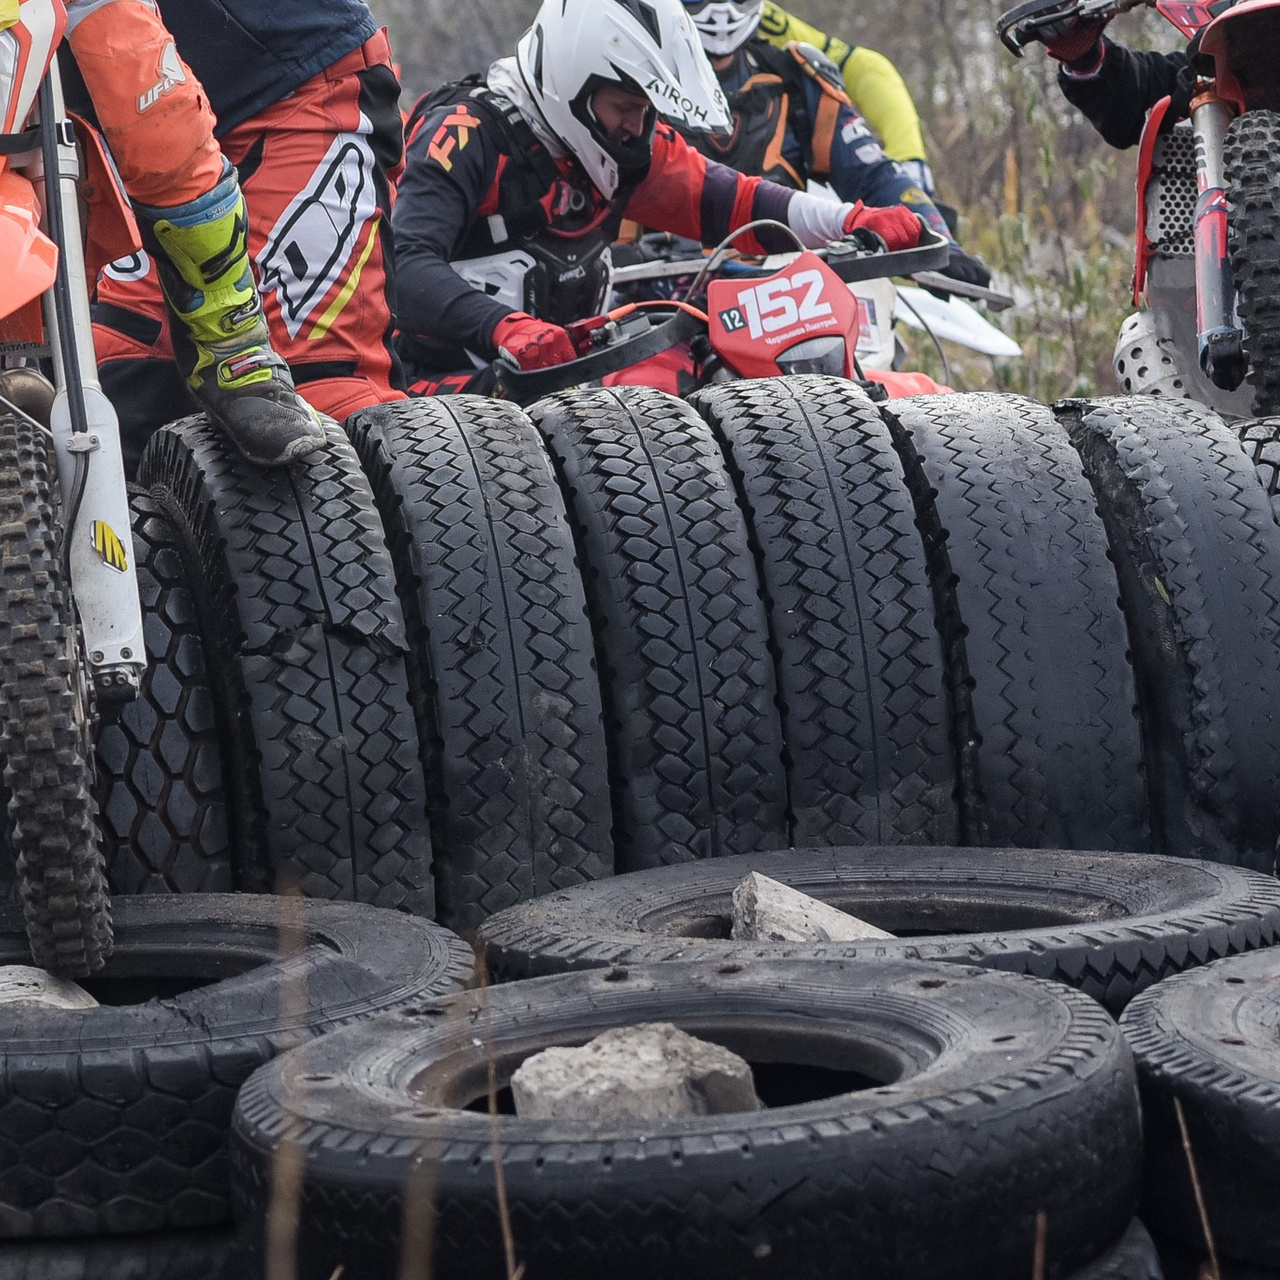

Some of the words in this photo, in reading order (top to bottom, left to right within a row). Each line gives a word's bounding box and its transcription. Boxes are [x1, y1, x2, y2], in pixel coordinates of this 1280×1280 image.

[644, 79, 709, 123] AIROH
[721, 309, 744, 330] 12
[737, 268, 833, 340] 152
